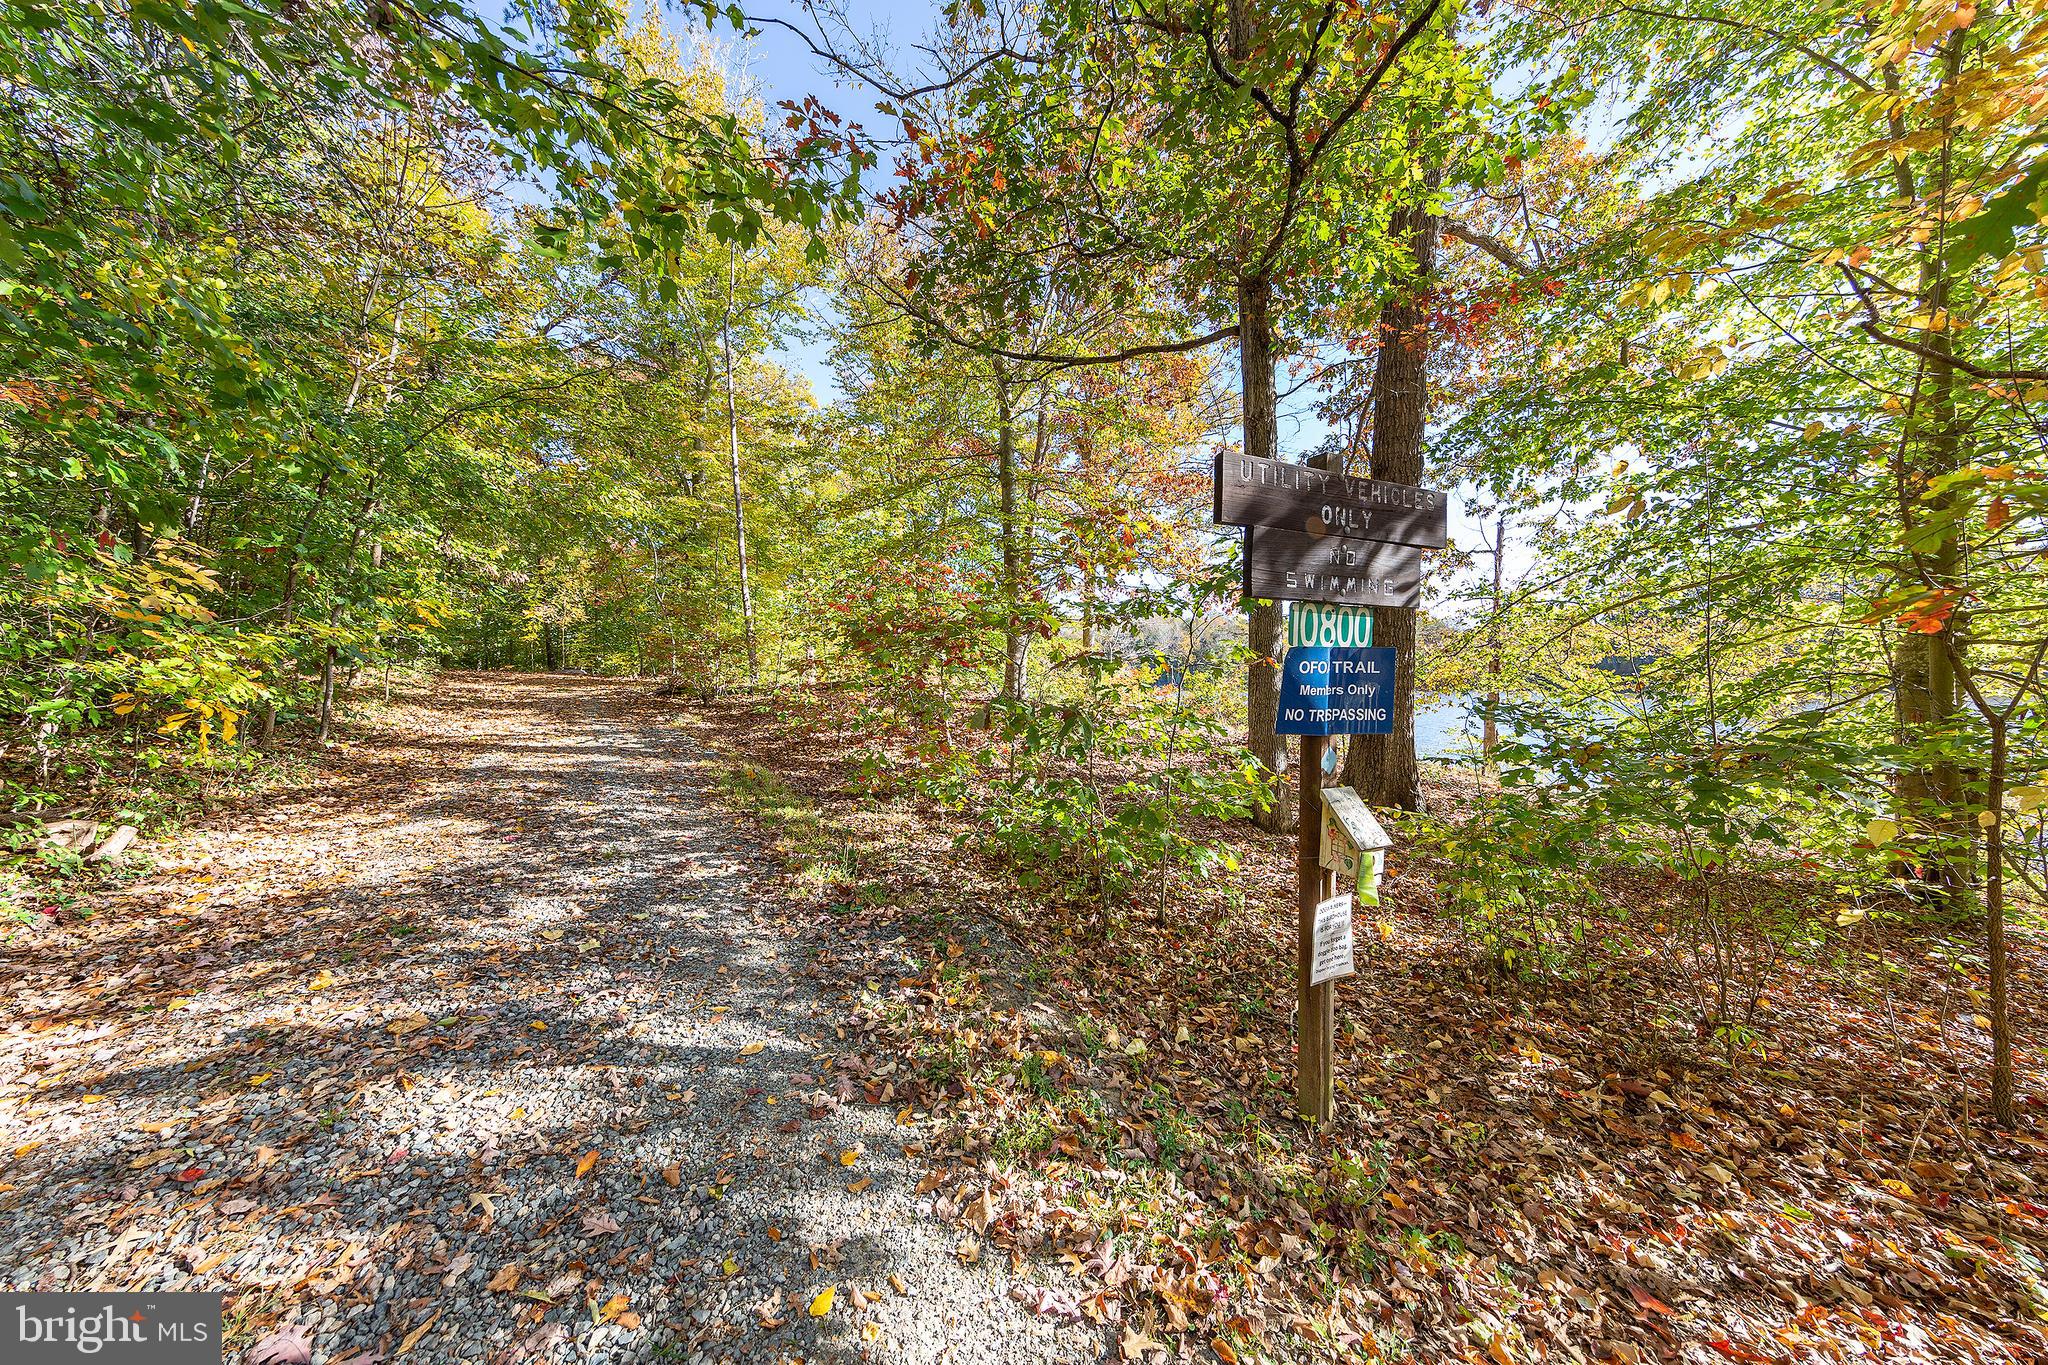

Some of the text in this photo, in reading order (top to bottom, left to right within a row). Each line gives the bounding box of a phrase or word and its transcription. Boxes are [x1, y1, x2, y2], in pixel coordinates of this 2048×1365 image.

[1240, 459, 1435, 511] UTILITY VEHICLES
[1321, 504, 1373, 530] ONLY
[1329, 547, 1357, 566] NO
[1286, 571, 1395, 597] SWIMMING
[1292, 603, 1371, 648] 10800
[1332, 660, 1381, 674] TRAIL
[1347, 683, 1376, 698] Only
[1284, 708, 1305, 721] NO
